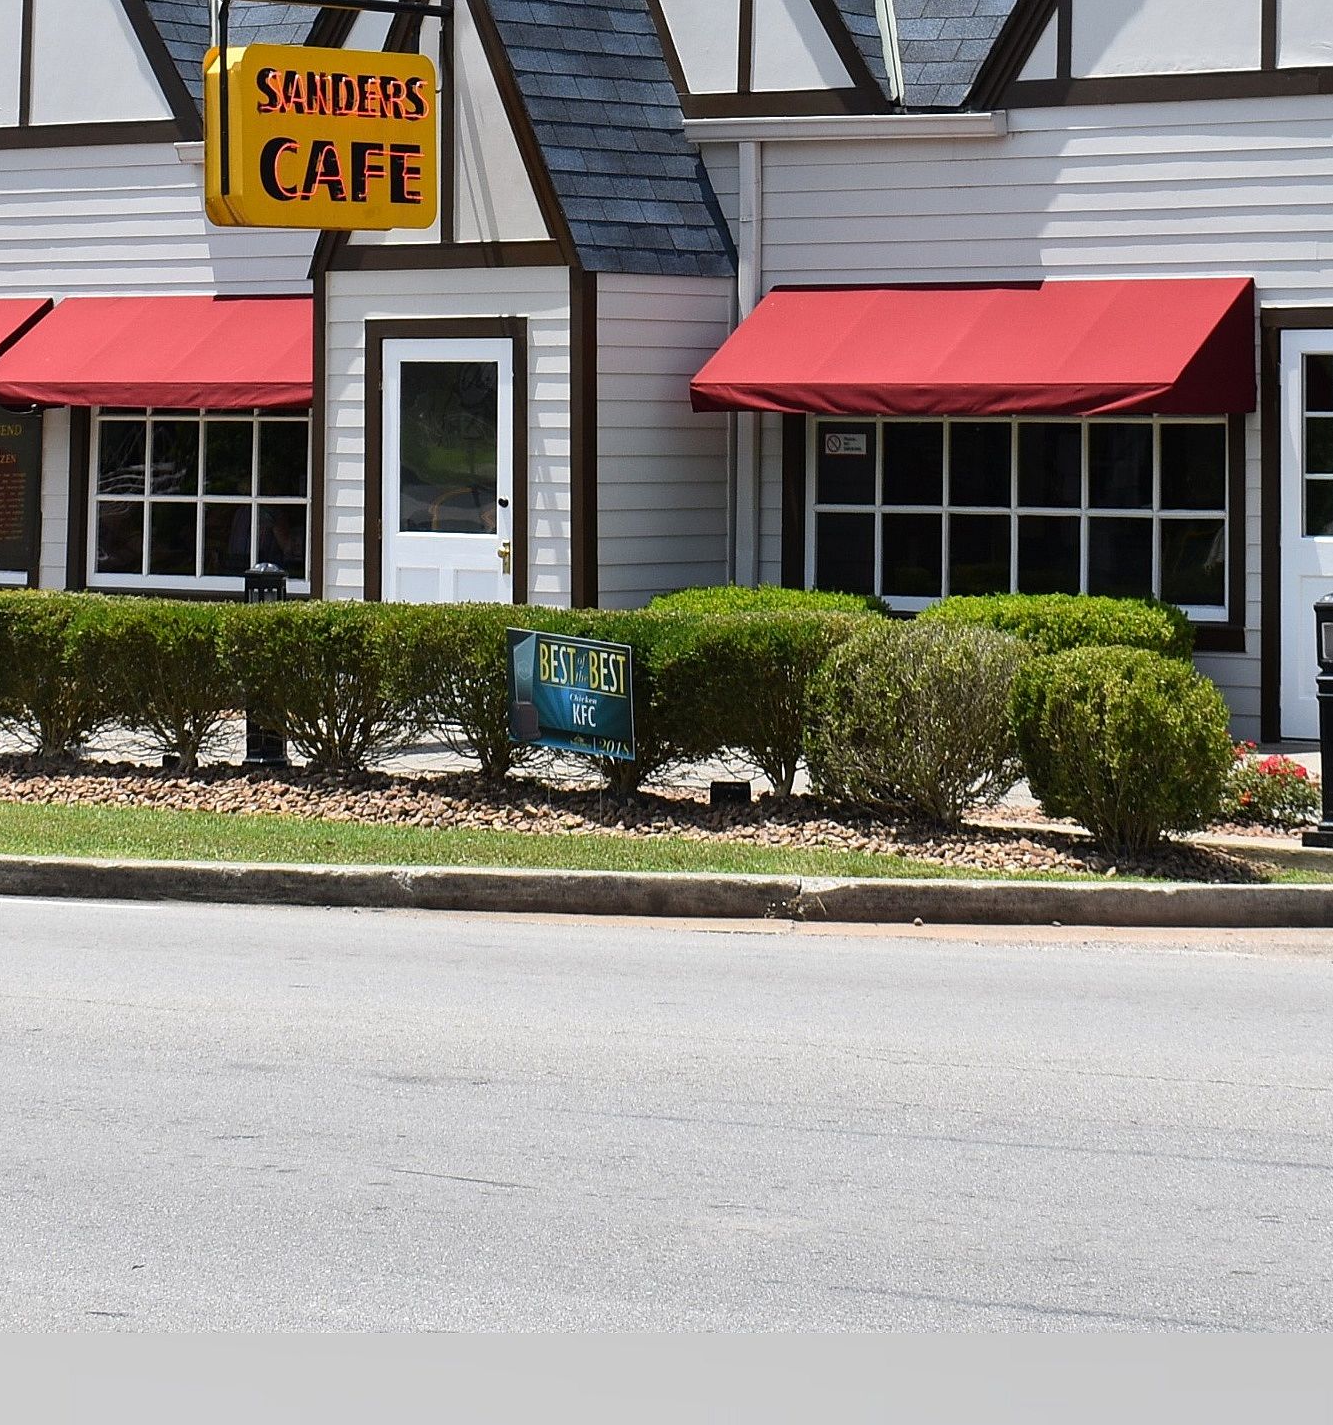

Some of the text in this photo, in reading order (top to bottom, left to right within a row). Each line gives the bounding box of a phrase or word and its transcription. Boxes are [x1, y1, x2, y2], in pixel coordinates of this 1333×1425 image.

[256, 67, 429, 121] SANDERS
[259, 136, 425, 204] CAFE
[539, 643, 626, 694] BEST of the BEST
[569, 693, 598, 705] Chicken
[572, 703, 597, 727] KFC
